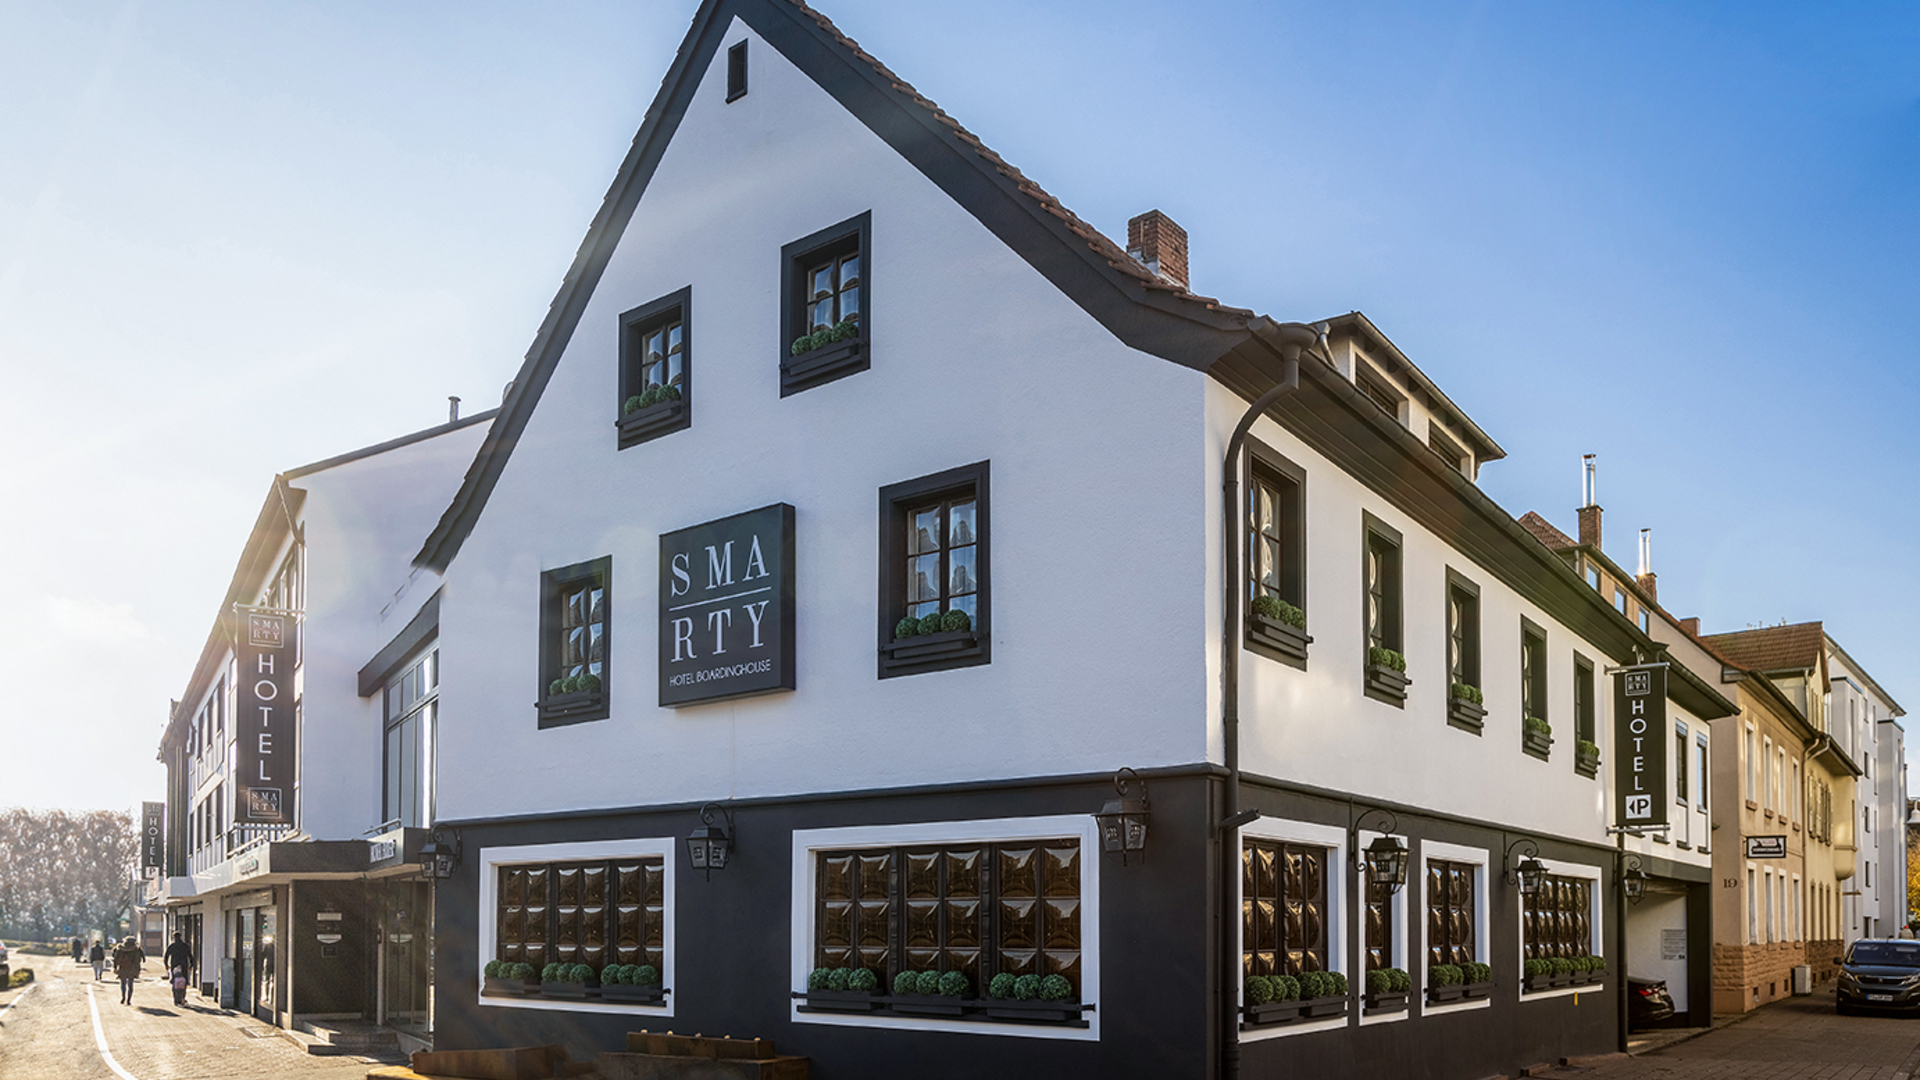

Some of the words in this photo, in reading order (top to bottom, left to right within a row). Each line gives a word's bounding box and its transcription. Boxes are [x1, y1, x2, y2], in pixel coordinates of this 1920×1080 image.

[671, 534, 770, 598] SMA
[671, 600, 769, 663] RTY
[669, 672, 695, 687] HOTEL
[696, 658, 771, 683] BOARDINGHOUSE
[254, 653, 278, 781] HOTEL
[1630, 699, 1647, 791] HOTEL
[1637, 798, 1649, 815] P
[148, 817, 158, 865] HOTEL
[1723, 878, 1738, 889] 19
